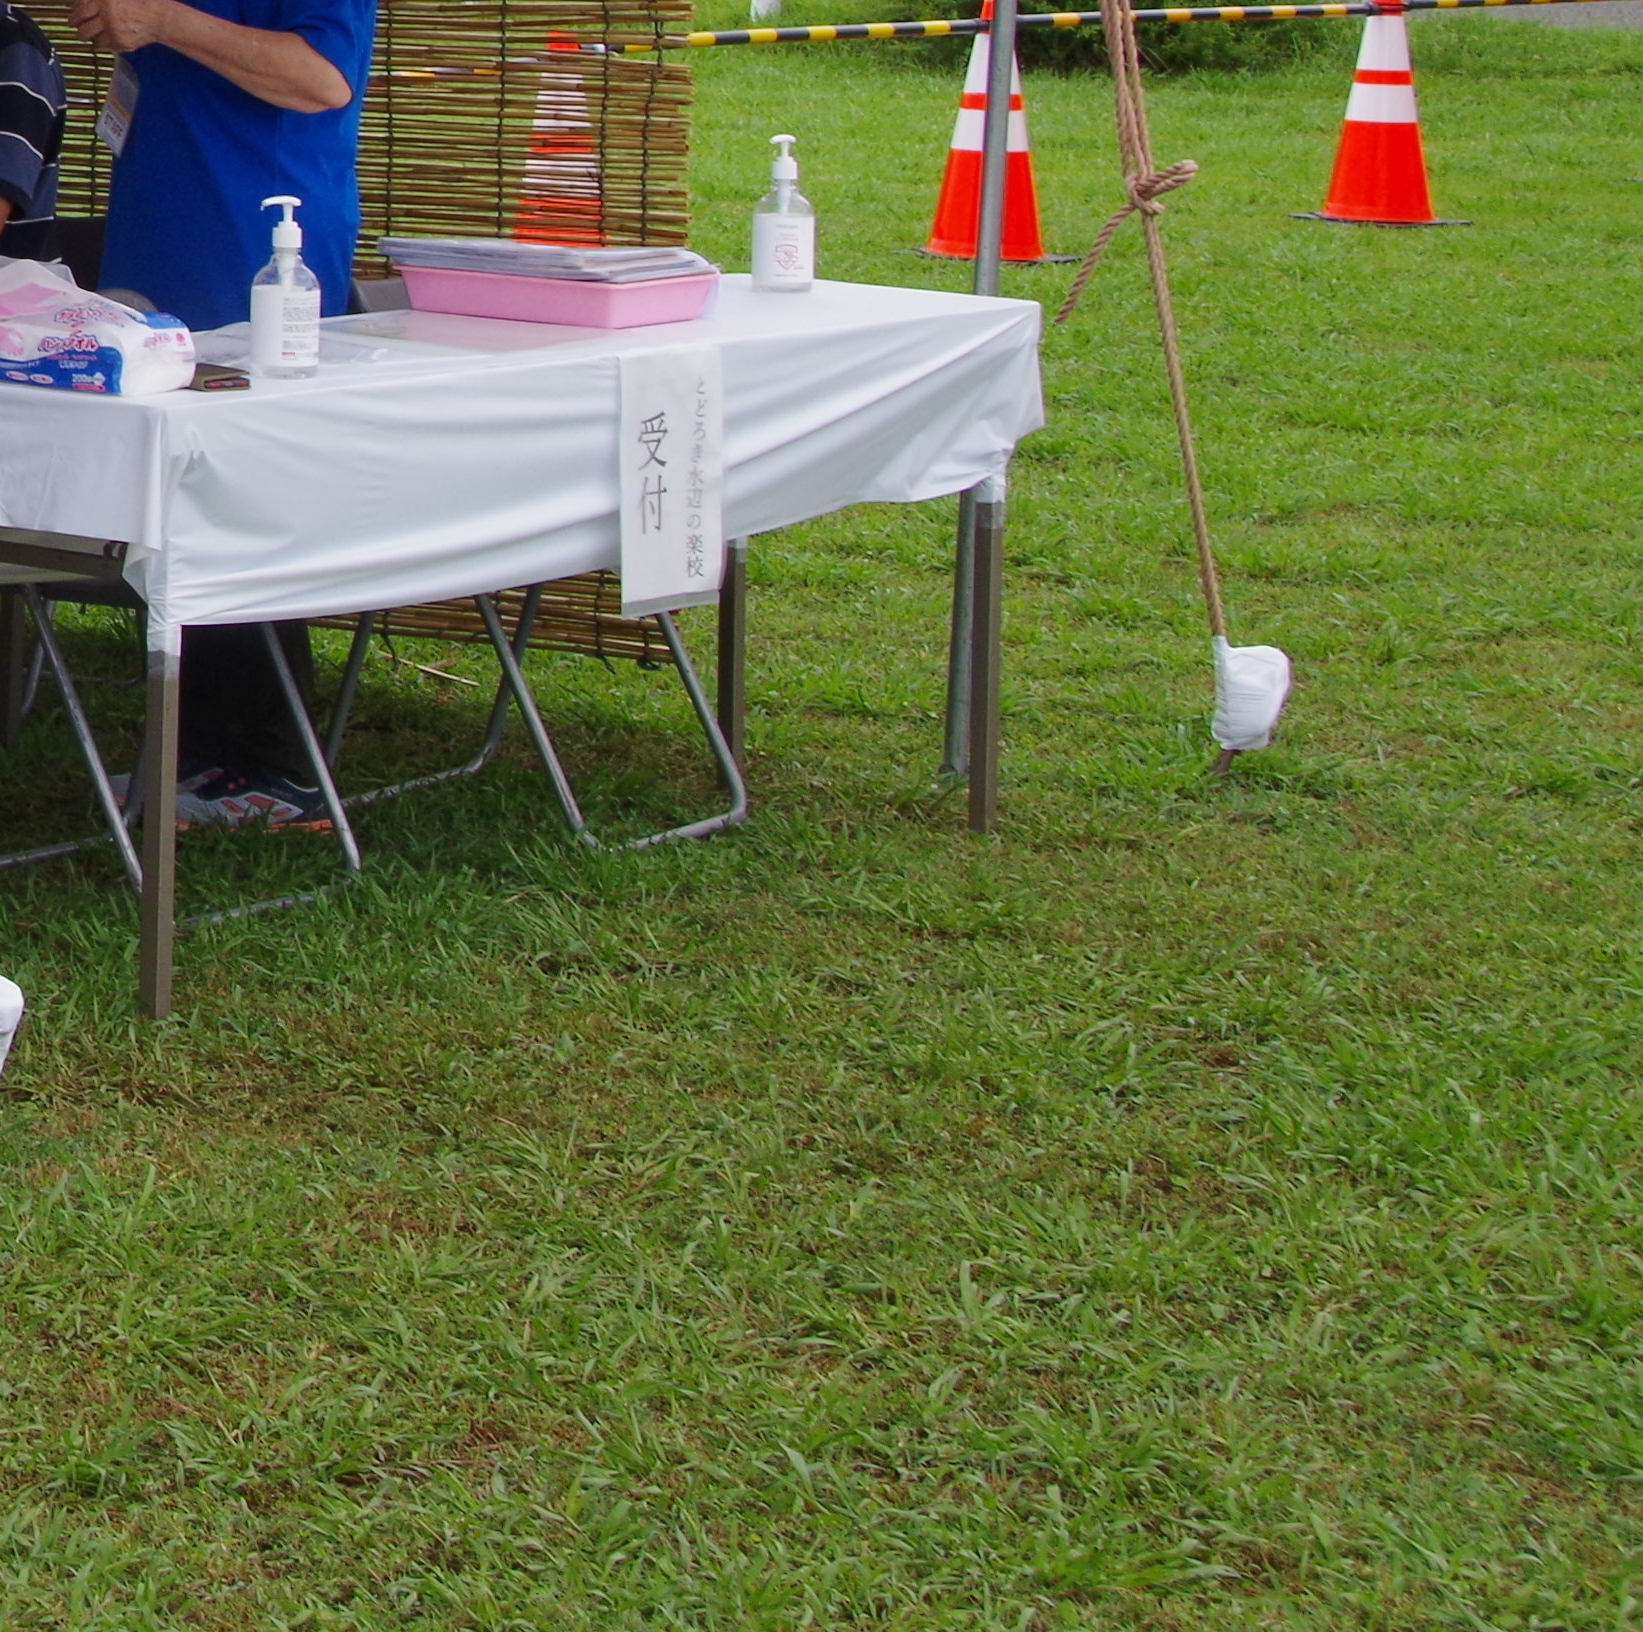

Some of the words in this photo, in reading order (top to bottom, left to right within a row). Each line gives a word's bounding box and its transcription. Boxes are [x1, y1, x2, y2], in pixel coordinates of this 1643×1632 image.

[636, 410, 669, 535] 受付
[685, 376, 708, 579] とどろき水辺の楽校
